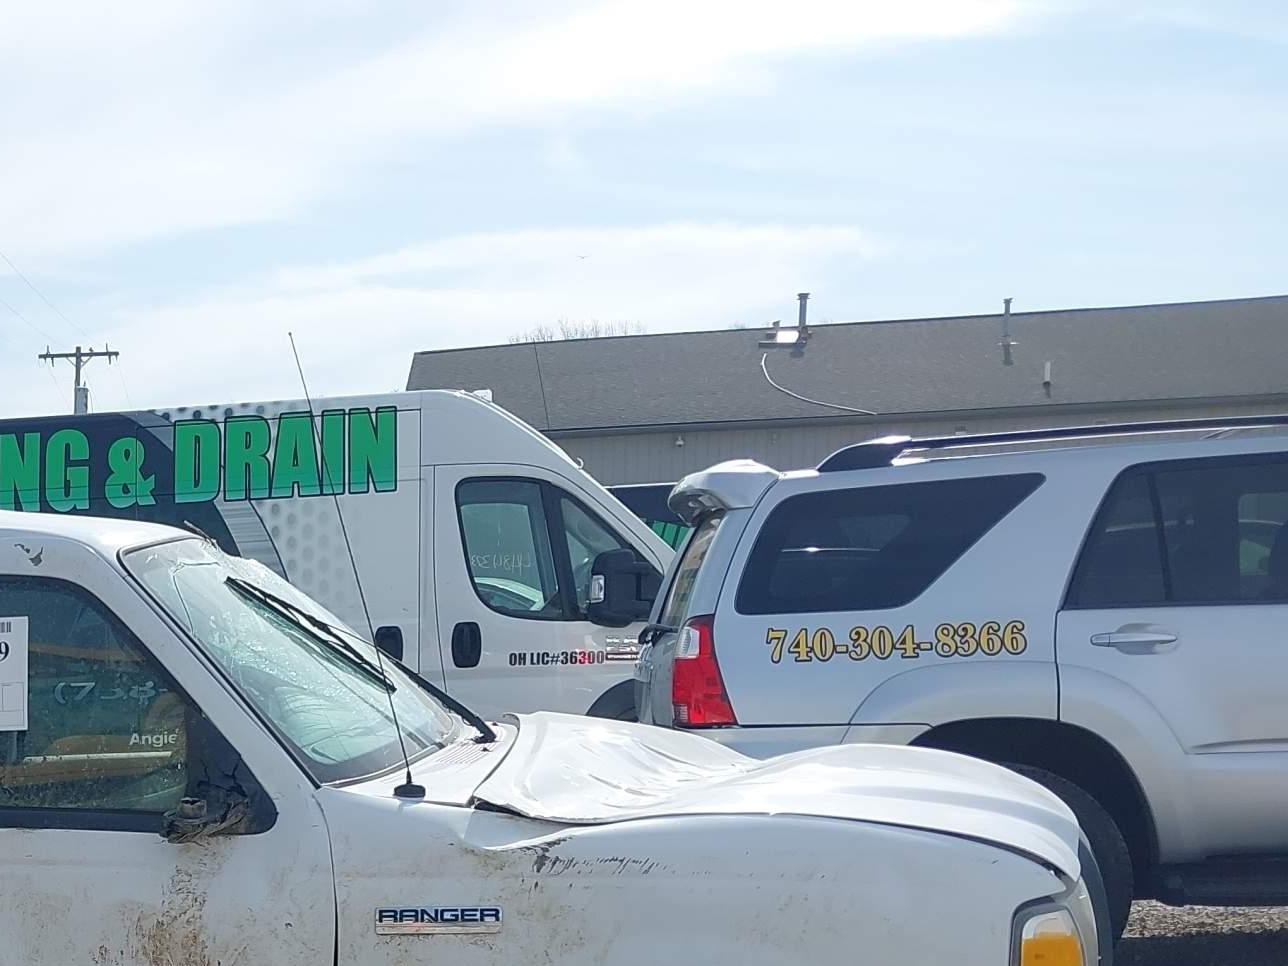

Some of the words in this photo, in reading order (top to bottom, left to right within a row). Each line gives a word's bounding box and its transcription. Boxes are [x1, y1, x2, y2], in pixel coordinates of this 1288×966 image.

[106, 436, 157, 509] &
[172, 405, 398, 504] DRAIN
[766, 620, 1027, 664] 740-304-8366
[509, 652, 527, 666] OH
[530, 651, 605, 666] LIC#36300
[378, 908, 500, 923] RANGER
